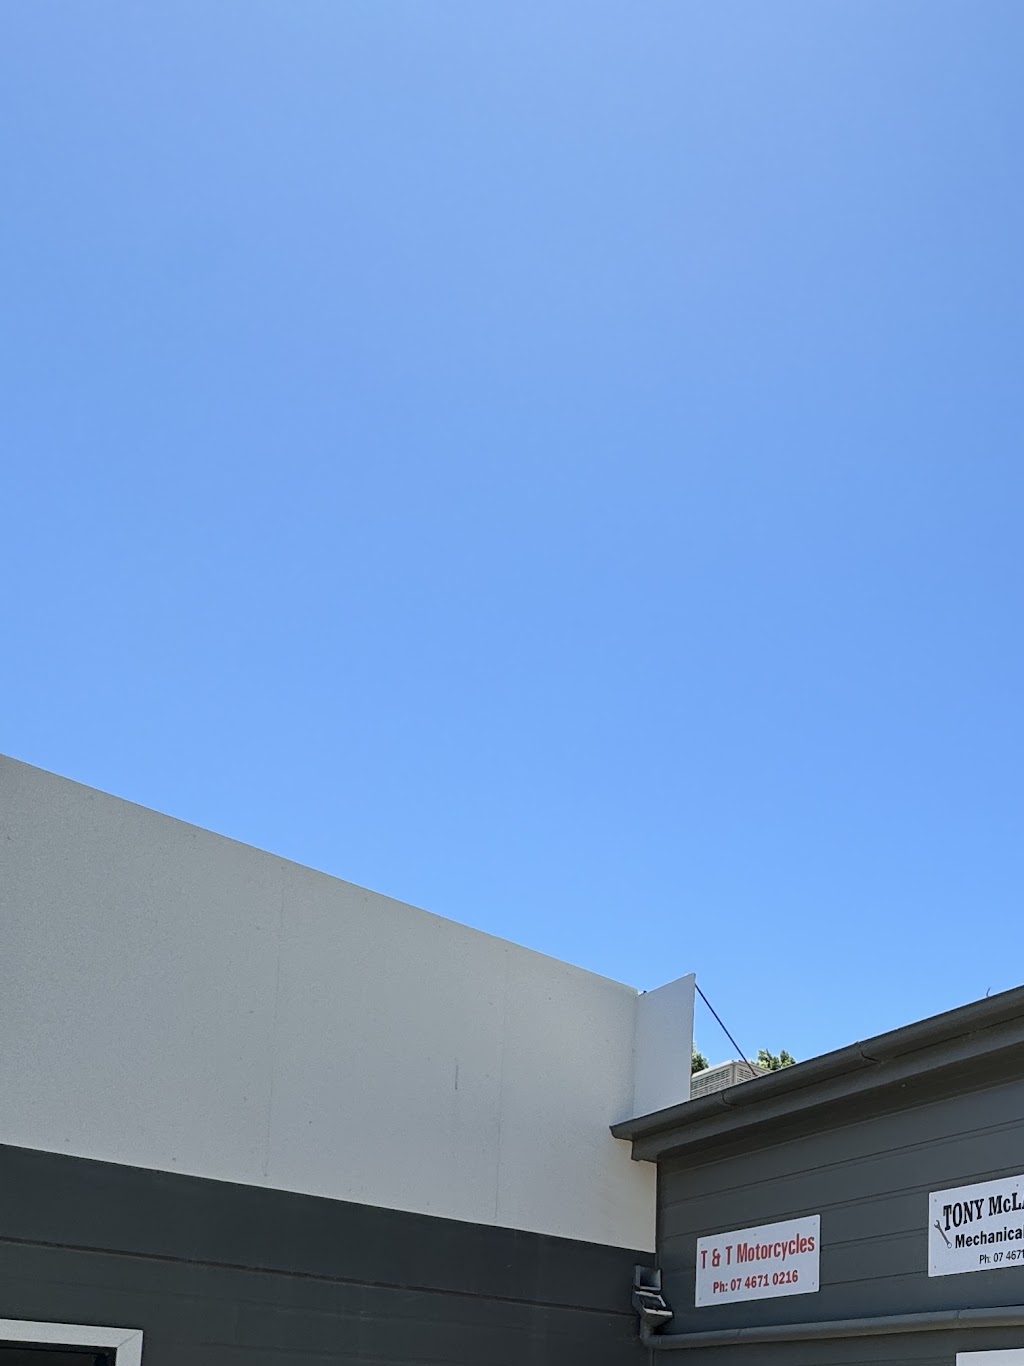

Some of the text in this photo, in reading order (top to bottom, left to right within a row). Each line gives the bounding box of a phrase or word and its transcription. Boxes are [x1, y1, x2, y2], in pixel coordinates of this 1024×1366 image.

[943, 1198, 984, 1231] TONY
[701, 1233, 815, 1269] T & T Motorcycles
[994, 1252, 1003, 1262] 07
[1006, 1249, 1024, 1260] 4671
[713, 1270, 798, 1294] Ph: 07 4671 0216
